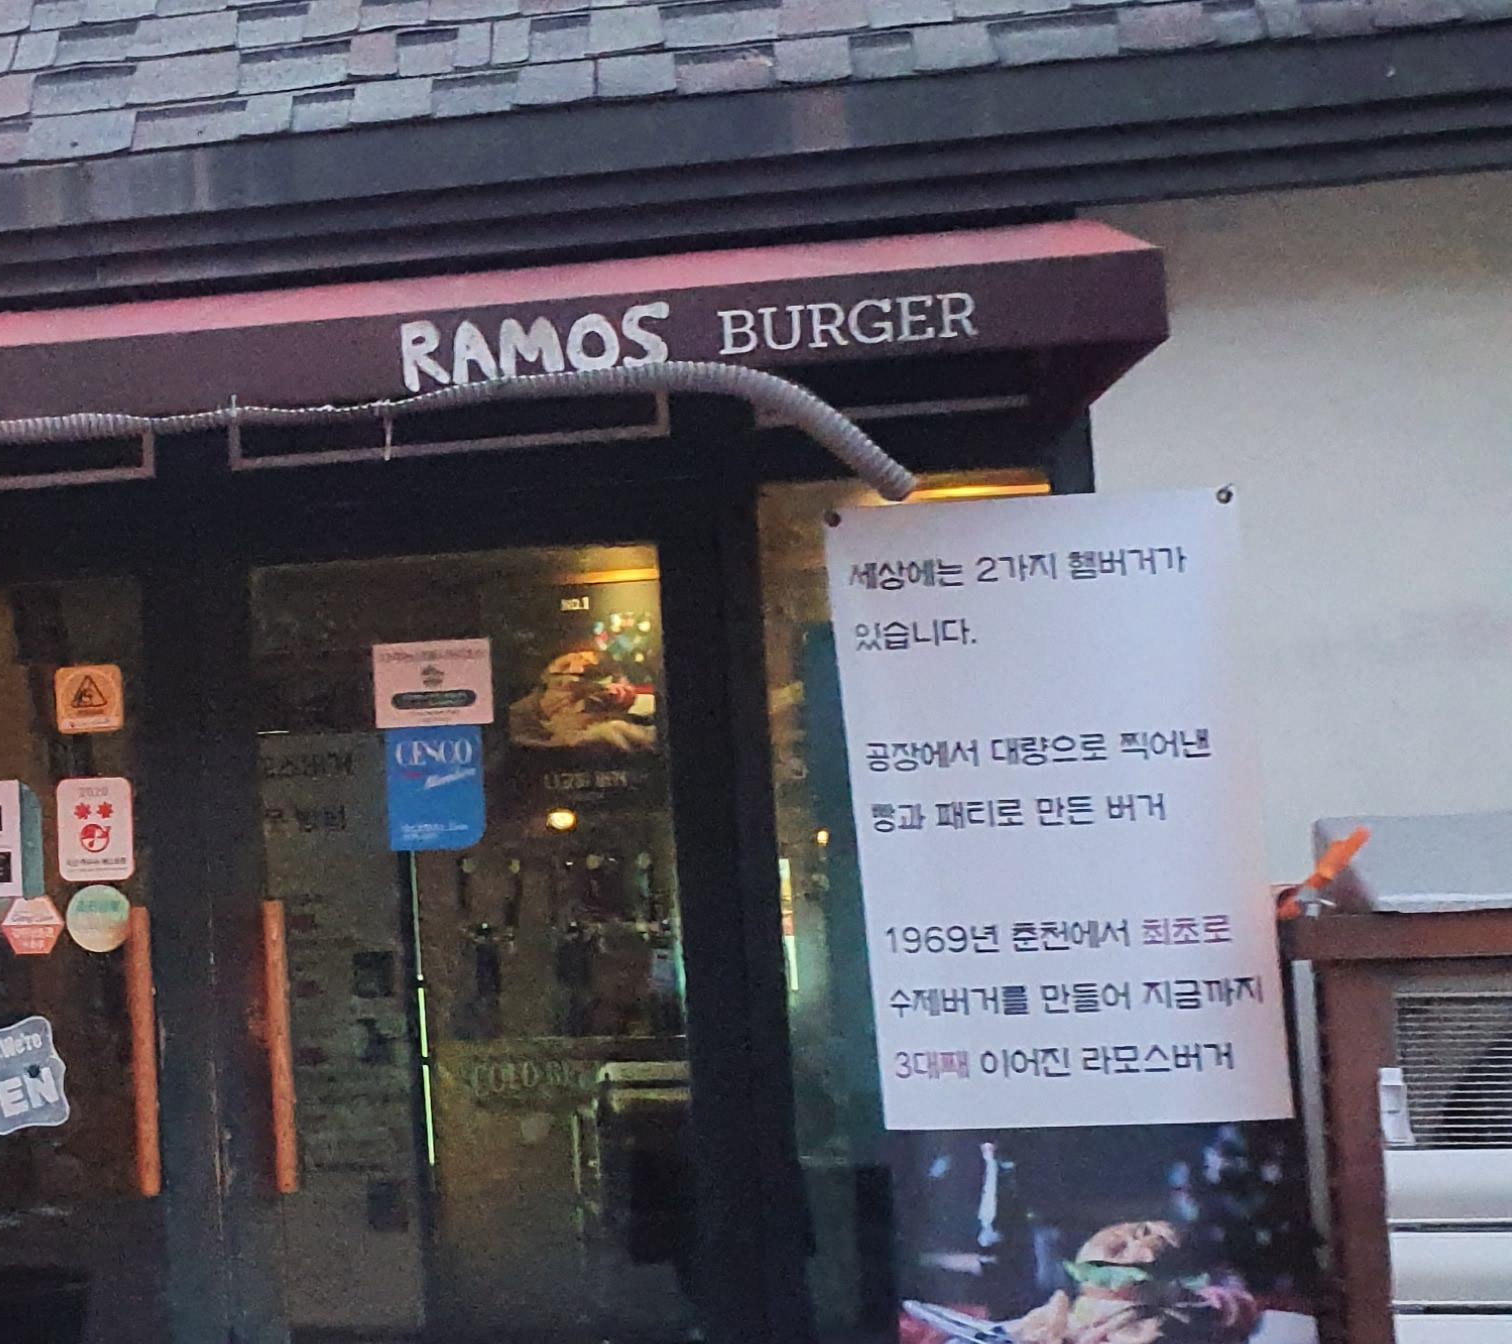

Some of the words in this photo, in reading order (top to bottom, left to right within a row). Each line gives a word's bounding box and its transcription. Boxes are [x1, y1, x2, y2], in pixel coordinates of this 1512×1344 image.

[401, 301, 670, 392] RAMOS
[718, 292, 978, 355] BURGER
[849, 559, 964, 590] 세상에는
[976, 553, 1057, 582] 2가지
[1068, 546, 1188, 580] 햄버거가
[855, 618, 977, 651] 있습니다.
[866, 739, 980, 772] 공장에서
[991, 733, 1107, 766] 대량으로
[1120, 728, 1212, 760] 찍어낸
[871, 802, 926, 833] 빵과
[935, 799, 1025, 830] 패티로
[1038, 795, 1095, 826] 만든
[1106, 793, 1166, 822] 버거
[886, 924, 1000, 955] 1969년
[1012, 919, 1130, 953] 춘천에서
[1142, 915, 1233, 946] 최초로
[890, 984, 1030, 1018] 수제버거를
[1040, 981, 1131, 1014] 만들어
[1143, 975, 1264, 1010] 지금까지
[980, 1047, 1071, 1079] 이어진
[1082, 1042, 1234, 1075] 라모스버거
